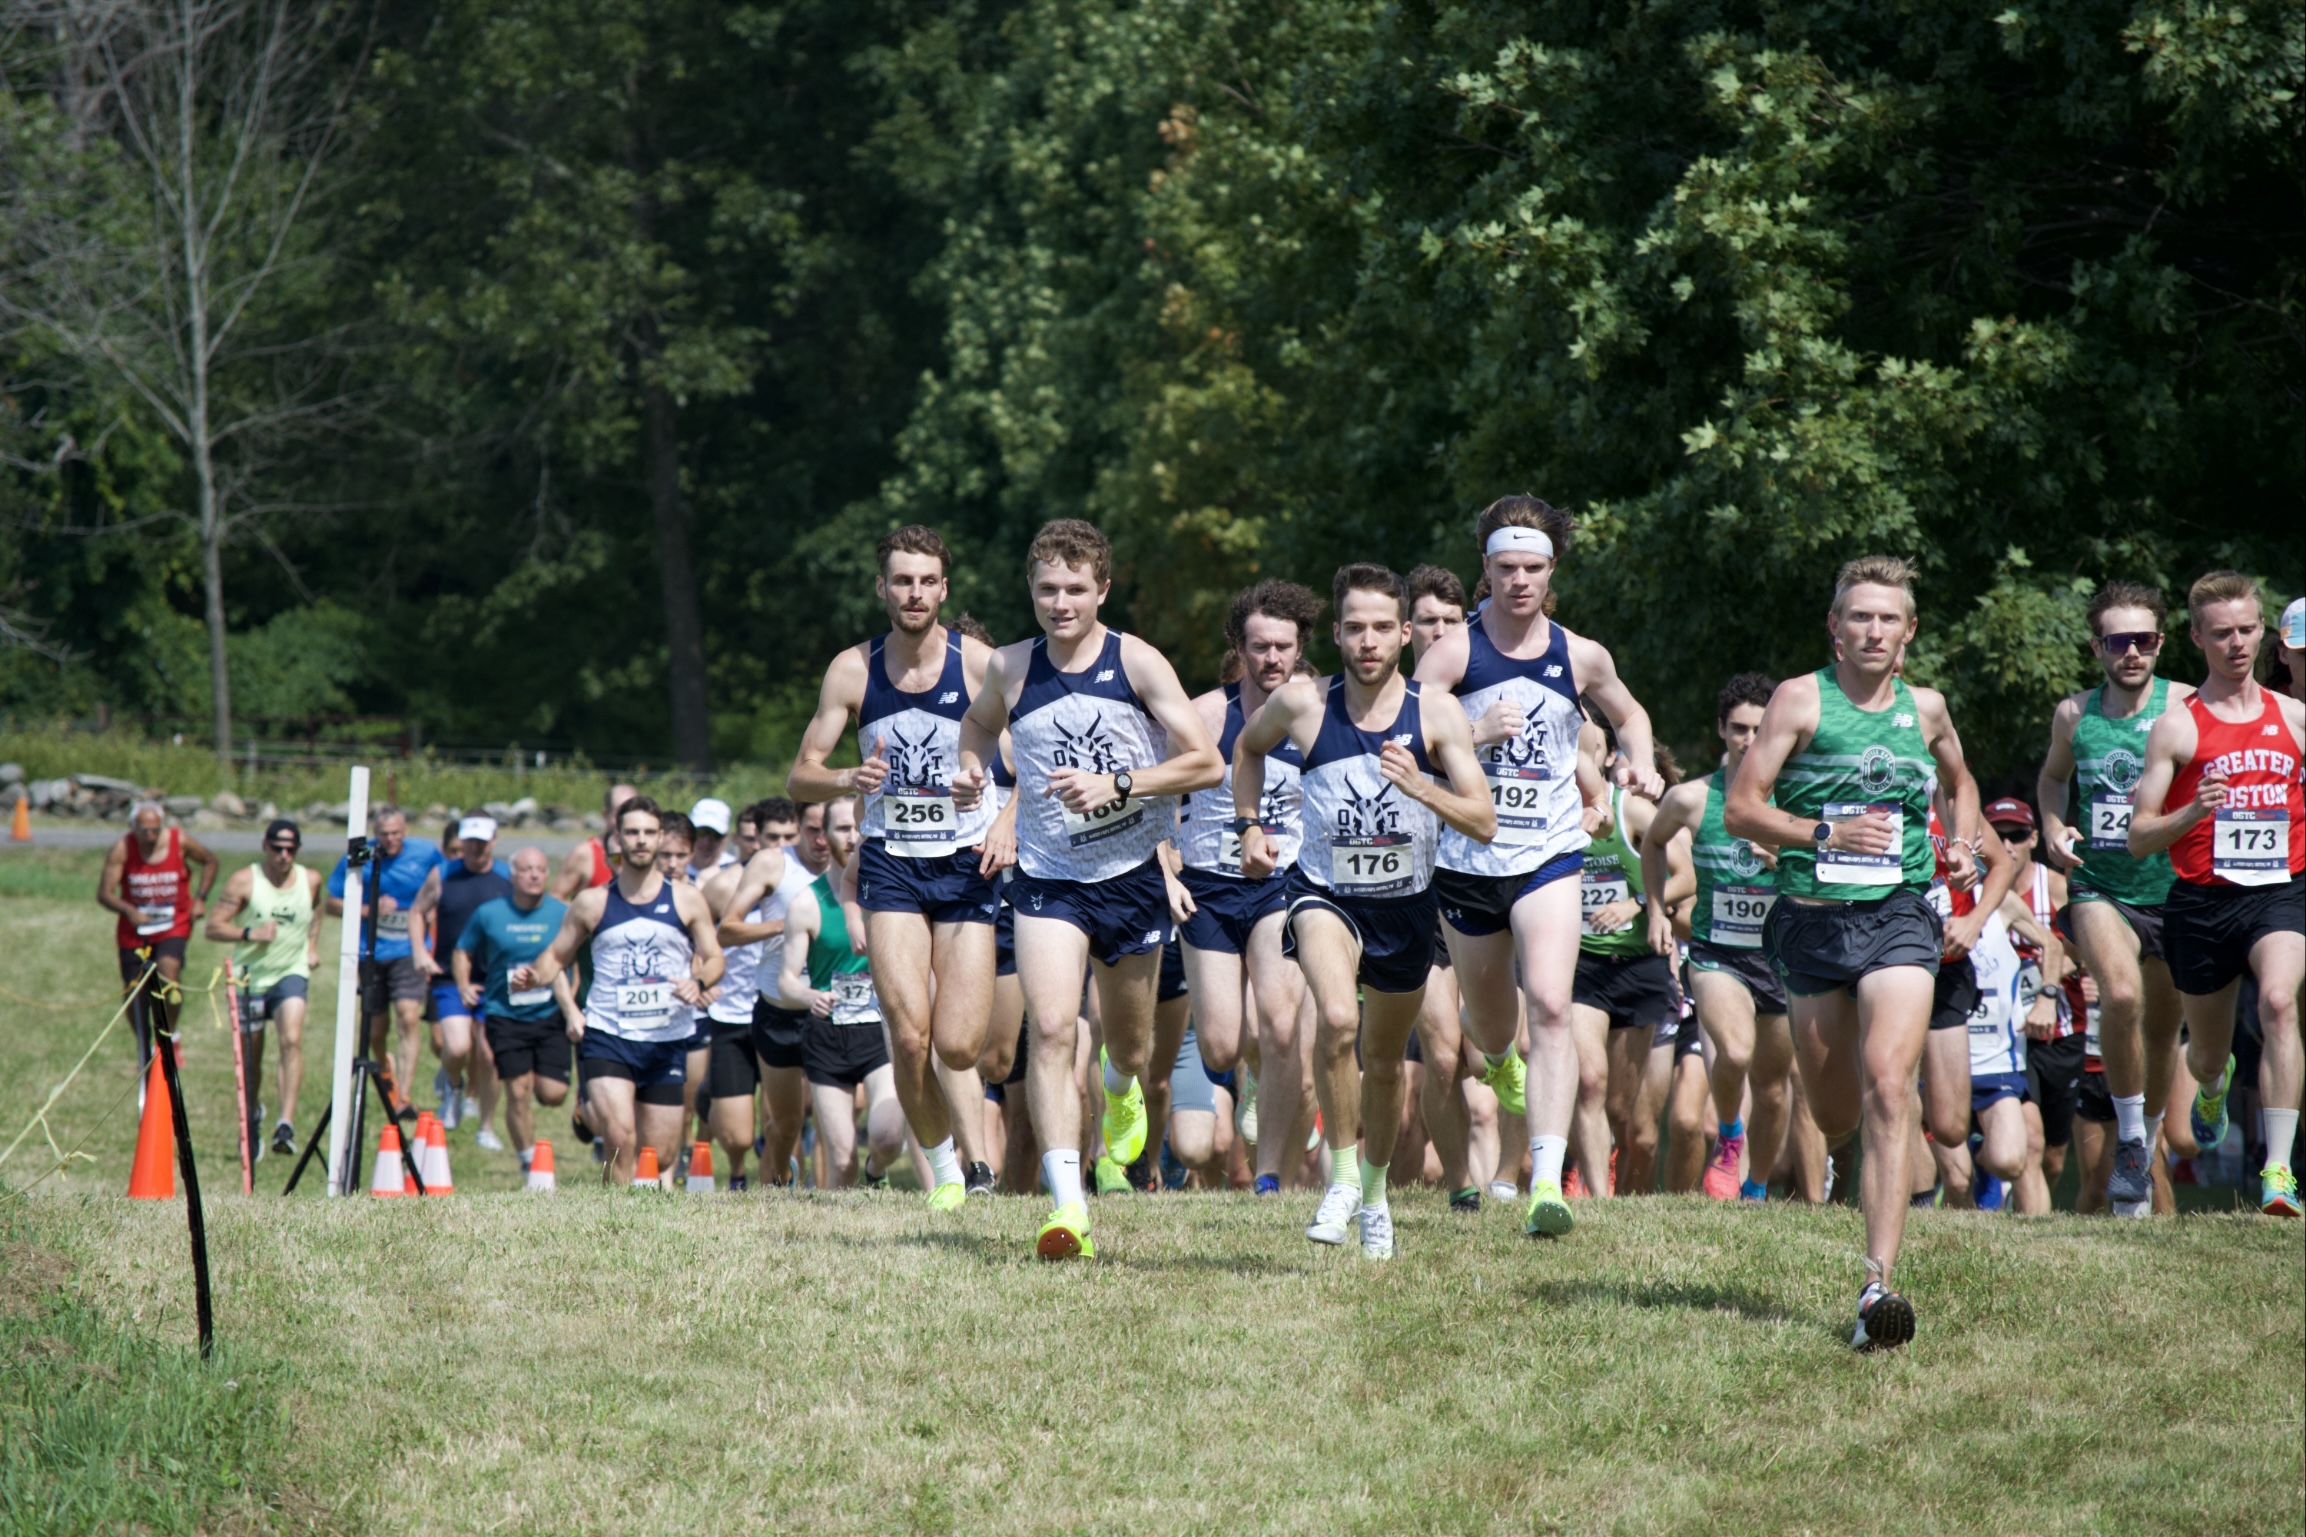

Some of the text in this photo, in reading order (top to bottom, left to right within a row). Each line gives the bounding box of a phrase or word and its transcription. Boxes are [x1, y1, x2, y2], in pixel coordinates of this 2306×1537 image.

[1496, 767, 1519, 777] OGTC
[2203, 748, 2295, 778] GREATER
[897, 787, 919, 796] OGTC
[1491, 785, 1538, 809] 192
[2106, 795, 2127, 804] OGTC
[2216, 783, 2289, 809] OSTON
[894, 803, 944, 823] 256
[1842, 805, 1867, 815] OGTC
[2232, 811, 2256, 820] OGTC
[2101, 811, 2131, 832] 24
[1349, 837, 1373, 846] OGTC
[2228, 829, 2276, 850] 173
[1347, 852, 1400, 875] 176
[1582, 888, 1619, 906] 222
[1723, 899, 1766, 918] 190
[626, 989, 659, 1005] 201
